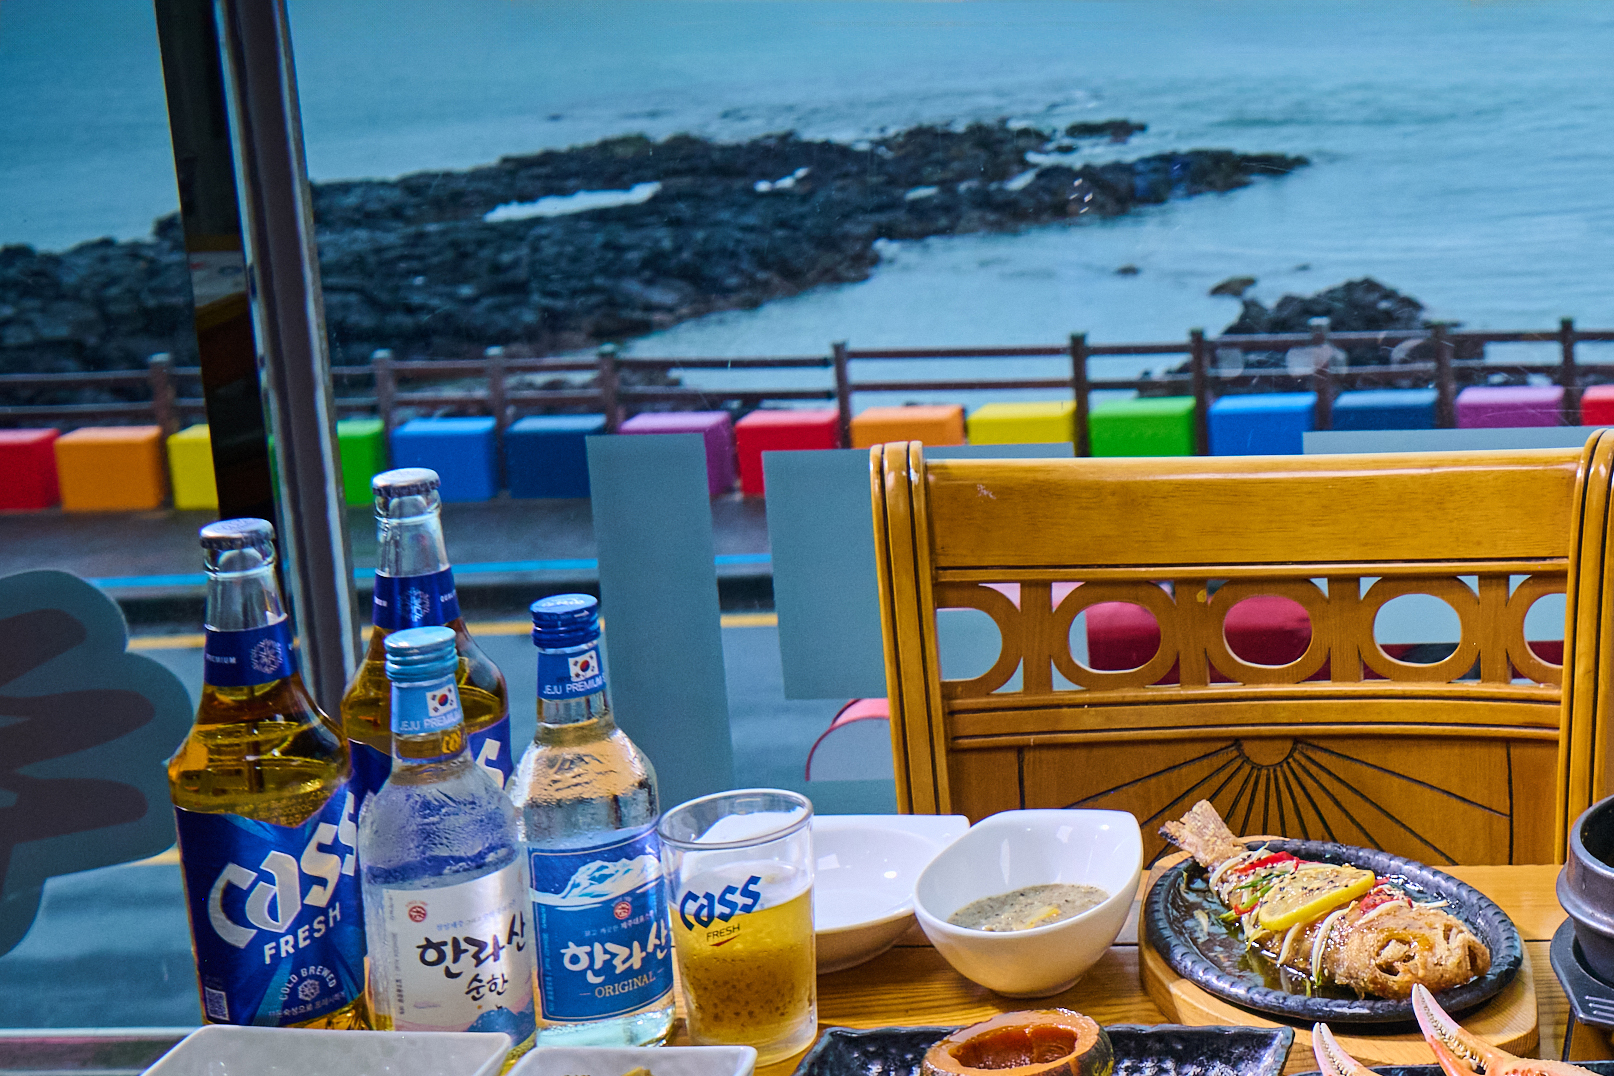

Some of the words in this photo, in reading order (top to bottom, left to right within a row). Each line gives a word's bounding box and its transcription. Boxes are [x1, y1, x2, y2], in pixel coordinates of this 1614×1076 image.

[263, 901, 341, 965] FRESH
[415, 910, 526, 979] 한라산
[705, 923, 741, 942] FRESH
[559, 918, 668, 984] 한라산
[279, 973, 300, 1001] COLD
[300, 965, 338, 989] BREWED
[464, 972, 509, 1002] 순한
[593, 970, 657, 999] ORIGINAL
